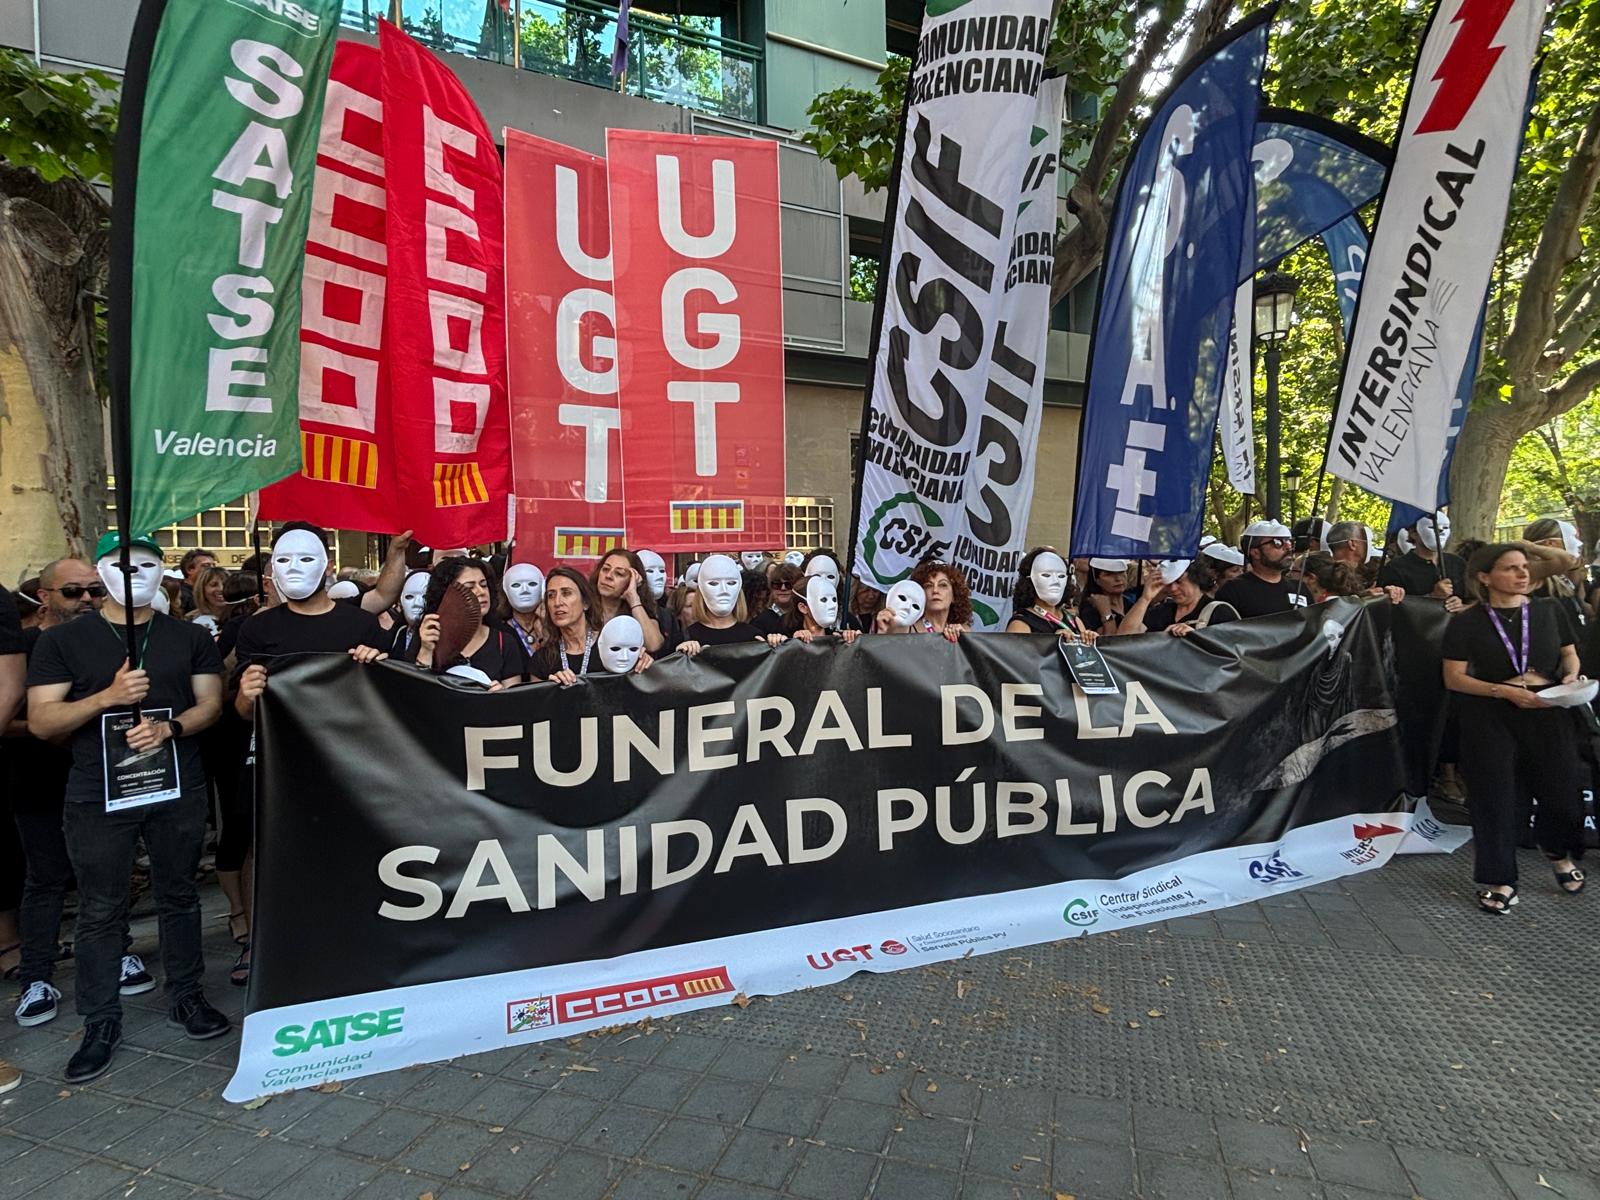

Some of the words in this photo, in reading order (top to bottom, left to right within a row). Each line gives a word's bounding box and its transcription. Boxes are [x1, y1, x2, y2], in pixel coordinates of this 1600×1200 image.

[204, 38, 305, 414] SATSE
[298, 79, 388, 435] CCOO
[422, 103, 492, 454] CCOO
[884, 110, 1004, 447] CSIF
[655, 153, 742, 477] UGT
[1337, 137, 1487, 471] INTERSINDICAL
[554, 163, 628, 504] UGT
[1359, 318, 1441, 484] VALENCIANA
[153, 429, 278, 458] Valencia
[879, 517, 953, 561] CSIF
[463, 686, 913, 792] FUNERAL
[939, 682, 1046, 746] DE
[1071, 680, 1178, 740] LA
[376, 796, 848, 922] SANIDAD
[876, 766, 1216, 852] PÚBLICA
[1100, 890, 1140, 907] Central
[1142, 874, 1183, 900] Sindical
[1107, 892, 1185, 914] Independiente
[1186, 889, 1195, 899] y
[1120, 912, 1136, 921] de
[1136, 899, 1208, 918] Funcionarios
[1071, 909, 1099, 922] CSIF
[806, 943, 874, 970] UGT
[921, 942, 959, 952] Serveis
[565, 983, 680, 1019] CCOO
[272, 1006, 405, 1057] SATSE
[261, 1062, 363, 1089] Valenciana
[264, 1050, 373, 1079] Comunidad
